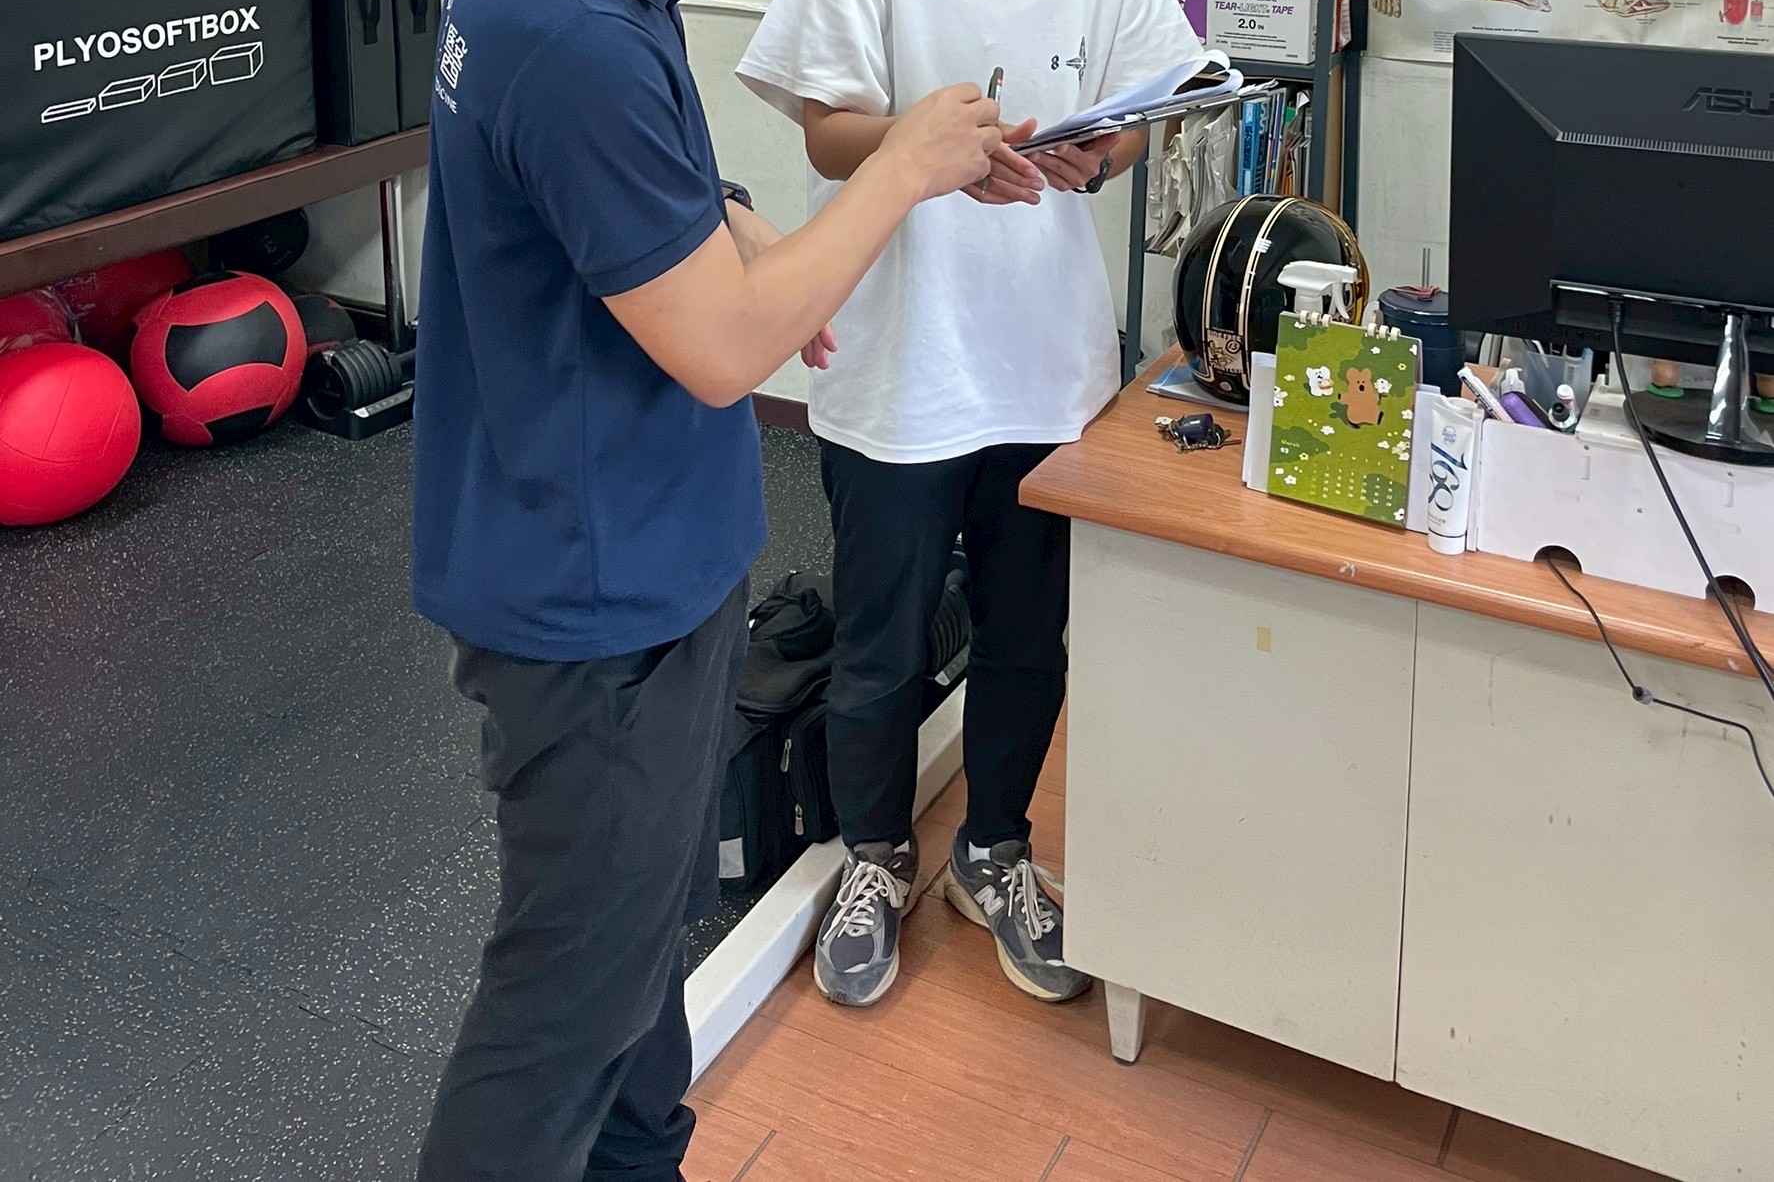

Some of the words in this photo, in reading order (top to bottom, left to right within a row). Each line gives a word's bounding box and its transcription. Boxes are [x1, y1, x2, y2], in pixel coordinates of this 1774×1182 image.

[1272, 5, 1294, 15] TAPE
[1238, 18, 1256, 30] 2.0
[33, 6, 260, 71] PLYOSOFTBOX
[1682, 87, 1774, 117] ASU
[1281, 439, 1300, 448] March
[974, 884, 1005, 917] N
